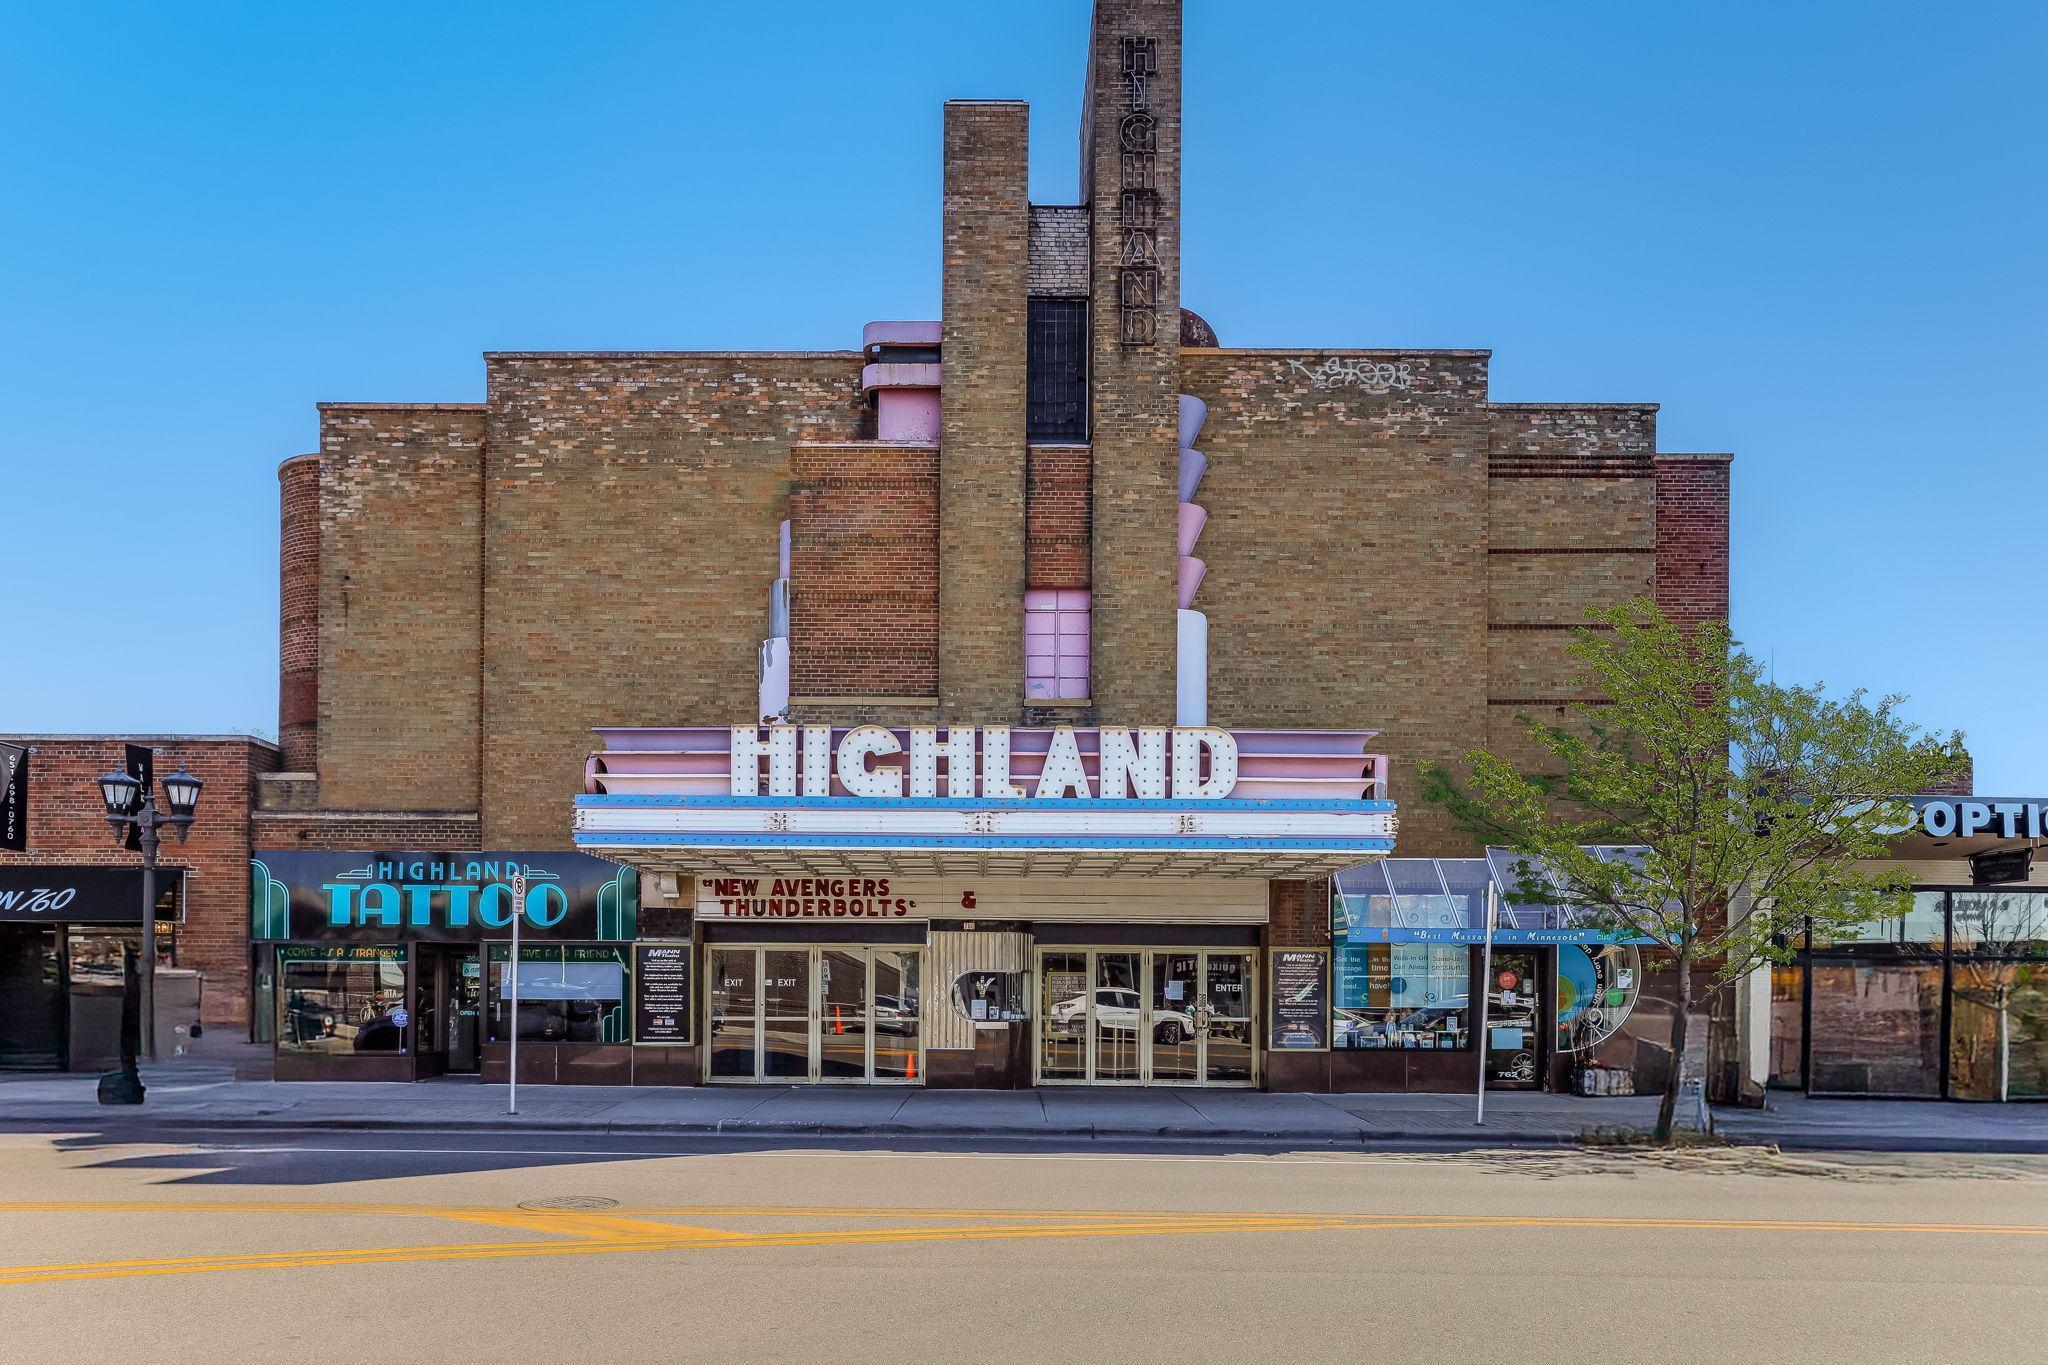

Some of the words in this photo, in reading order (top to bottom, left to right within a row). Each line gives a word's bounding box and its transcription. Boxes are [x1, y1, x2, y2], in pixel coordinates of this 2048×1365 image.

[1120, 37, 1160, 344] HIGHLAND
[731, 724, 1238, 799] HIGHLAND
[379, 861, 520, 880] HIGHLAND
[771, 878, 889, 897] AVENGERS
[16, 888, 76, 912] 760
[323, 884, 567, 926] TATTOO
[1508, 931, 1518, 940] in
[287, 947, 316, 957] COME
[320, 947, 334, 957] AS
[336, 947, 344, 957] A
[348, 947, 398, 958] STRANGER
[545, 948, 559, 959] AS
[574, 948, 609, 959] FRIEND
[725, 979, 744, 987] EXIT
[778, 979, 797, 987] EXIT
[1215, 984, 1243, 992] ENTER
